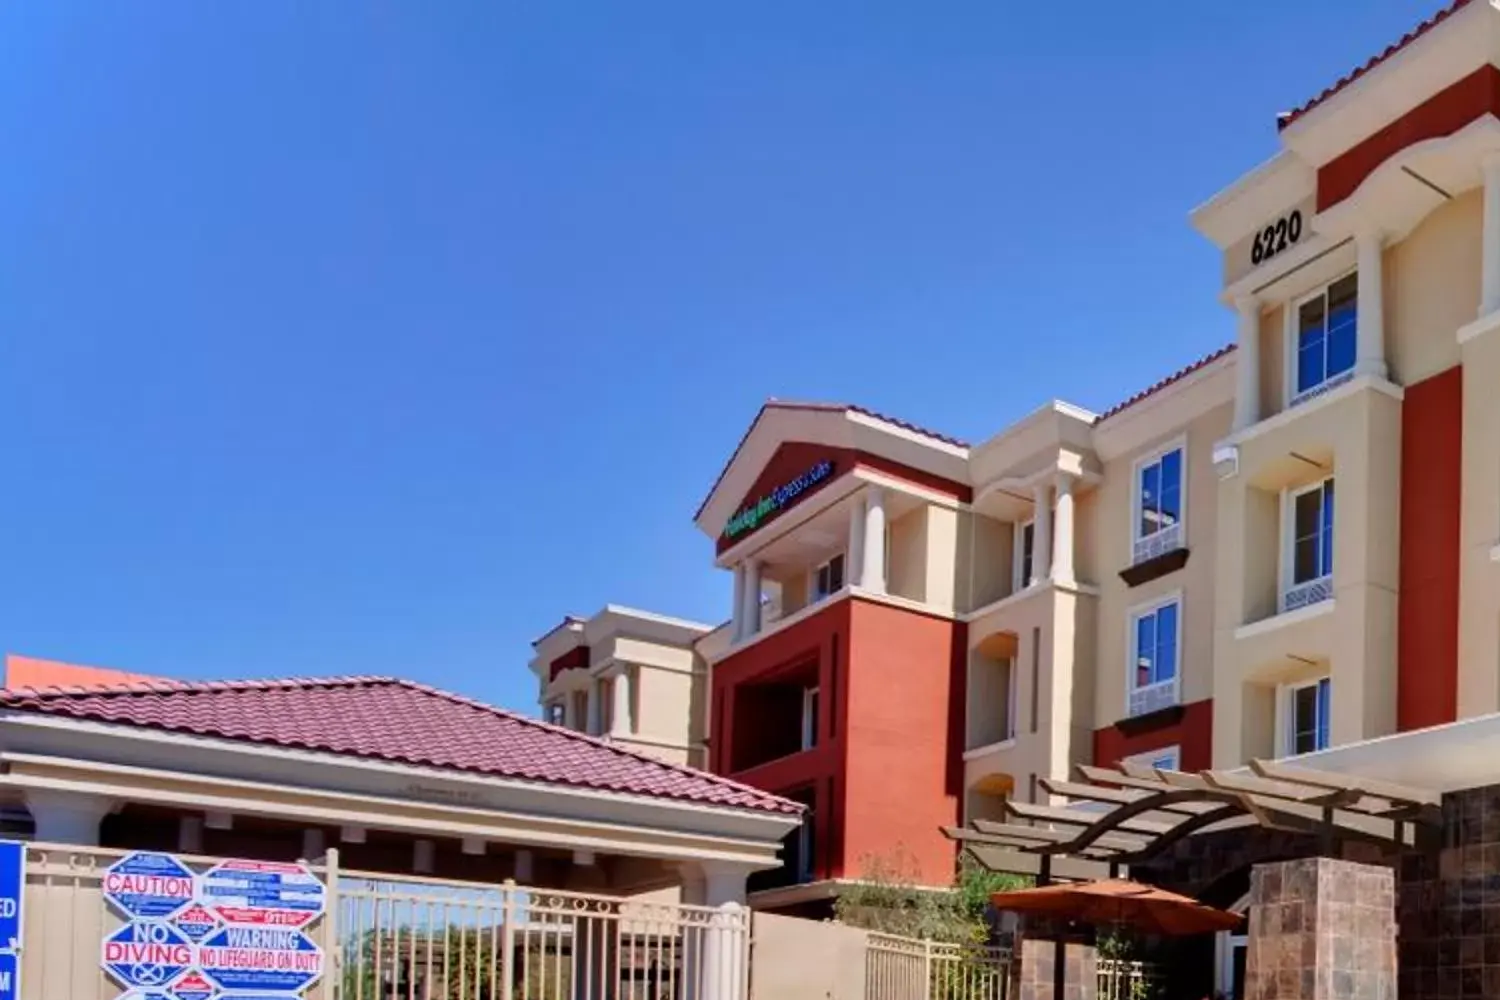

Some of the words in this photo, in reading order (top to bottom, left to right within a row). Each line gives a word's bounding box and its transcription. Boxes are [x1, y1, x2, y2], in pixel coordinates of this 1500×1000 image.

[1251, 210, 1302, 265] 6220
[106, 873, 193, 897] CAUTION
[132, 922, 169, 943] NO
[227, 928, 300, 950] WARNING
[105, 943, 192, 965] DIVING
[199, 949, 216, 967] NO
[218, 950, 275, 969] LIFEGUARD
[277, 951, 294, 969] ON
[295, 953, 321, 972] DUTY
